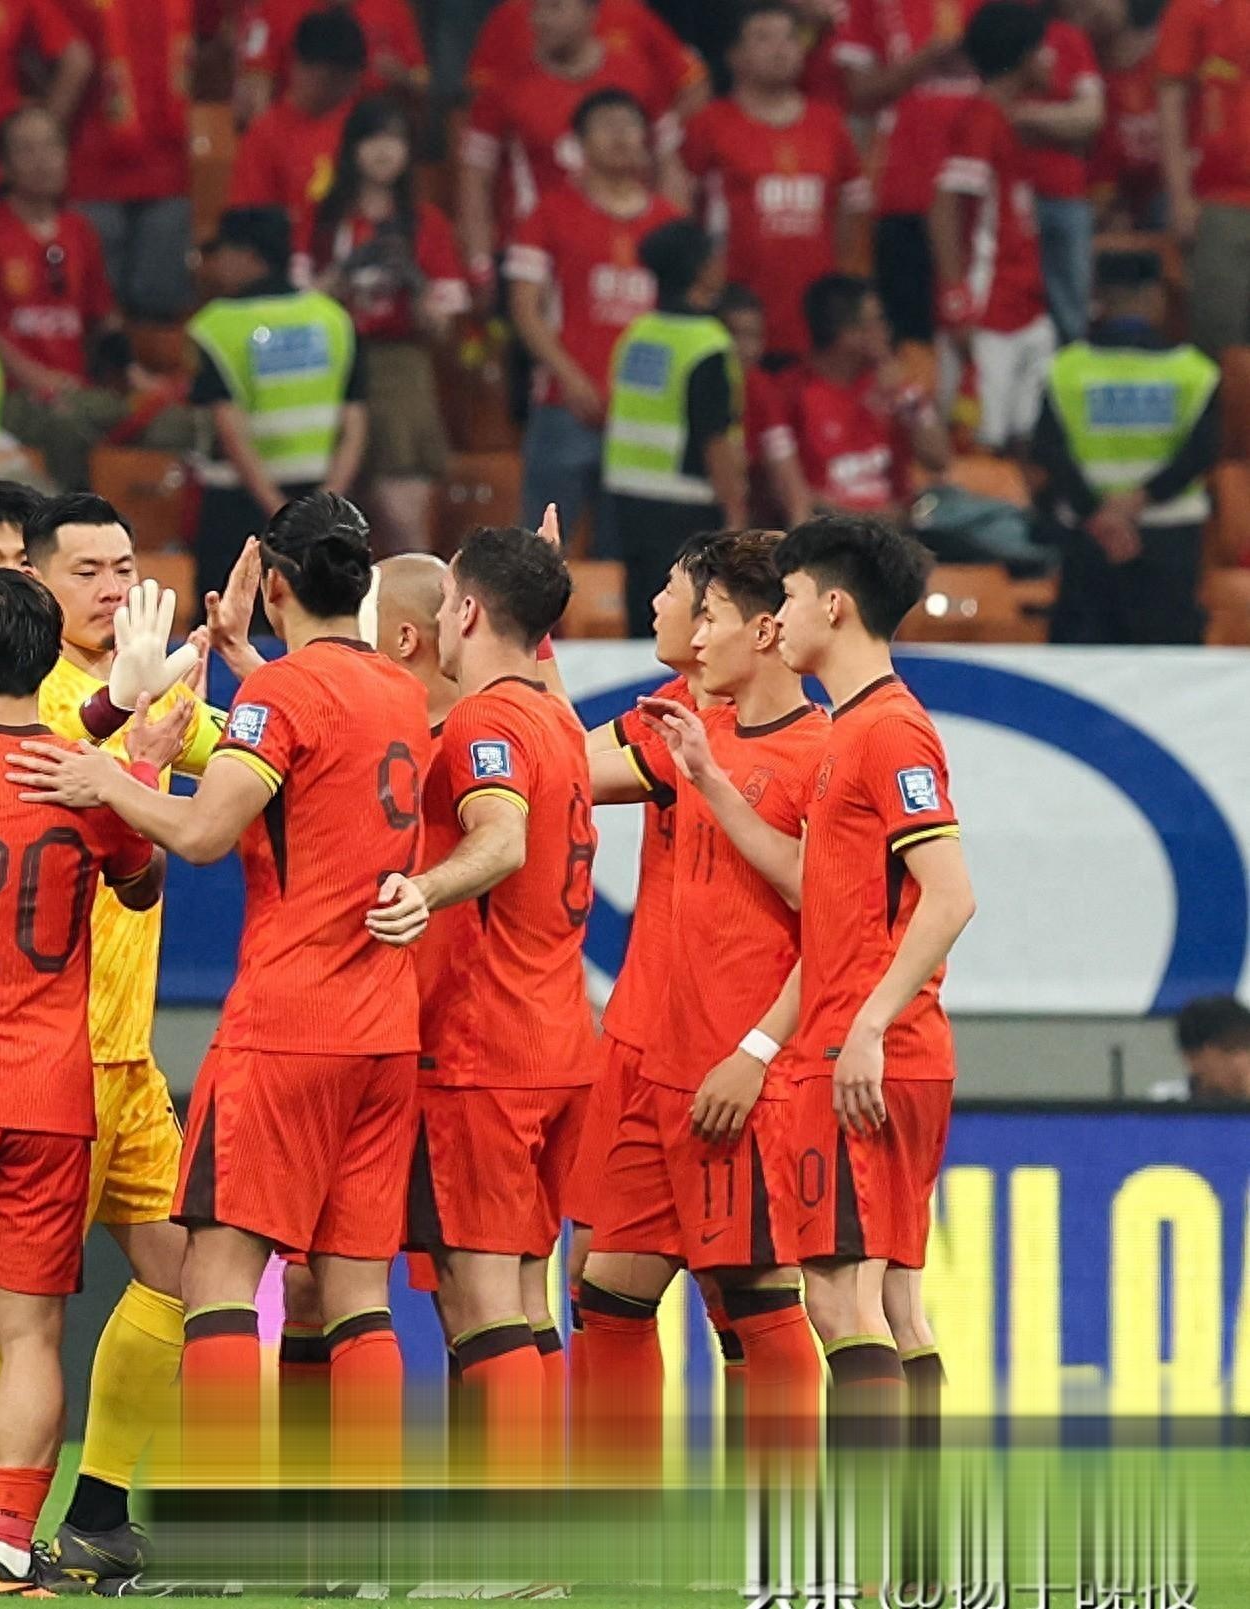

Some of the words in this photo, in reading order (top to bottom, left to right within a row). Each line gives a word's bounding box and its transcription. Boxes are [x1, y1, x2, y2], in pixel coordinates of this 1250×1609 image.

[377, 740, 419, 887] 9
[561, 783, 595, 927] 8
[691, 822, 716, 884] 11
[700, 1157, 733, 1219] 11
